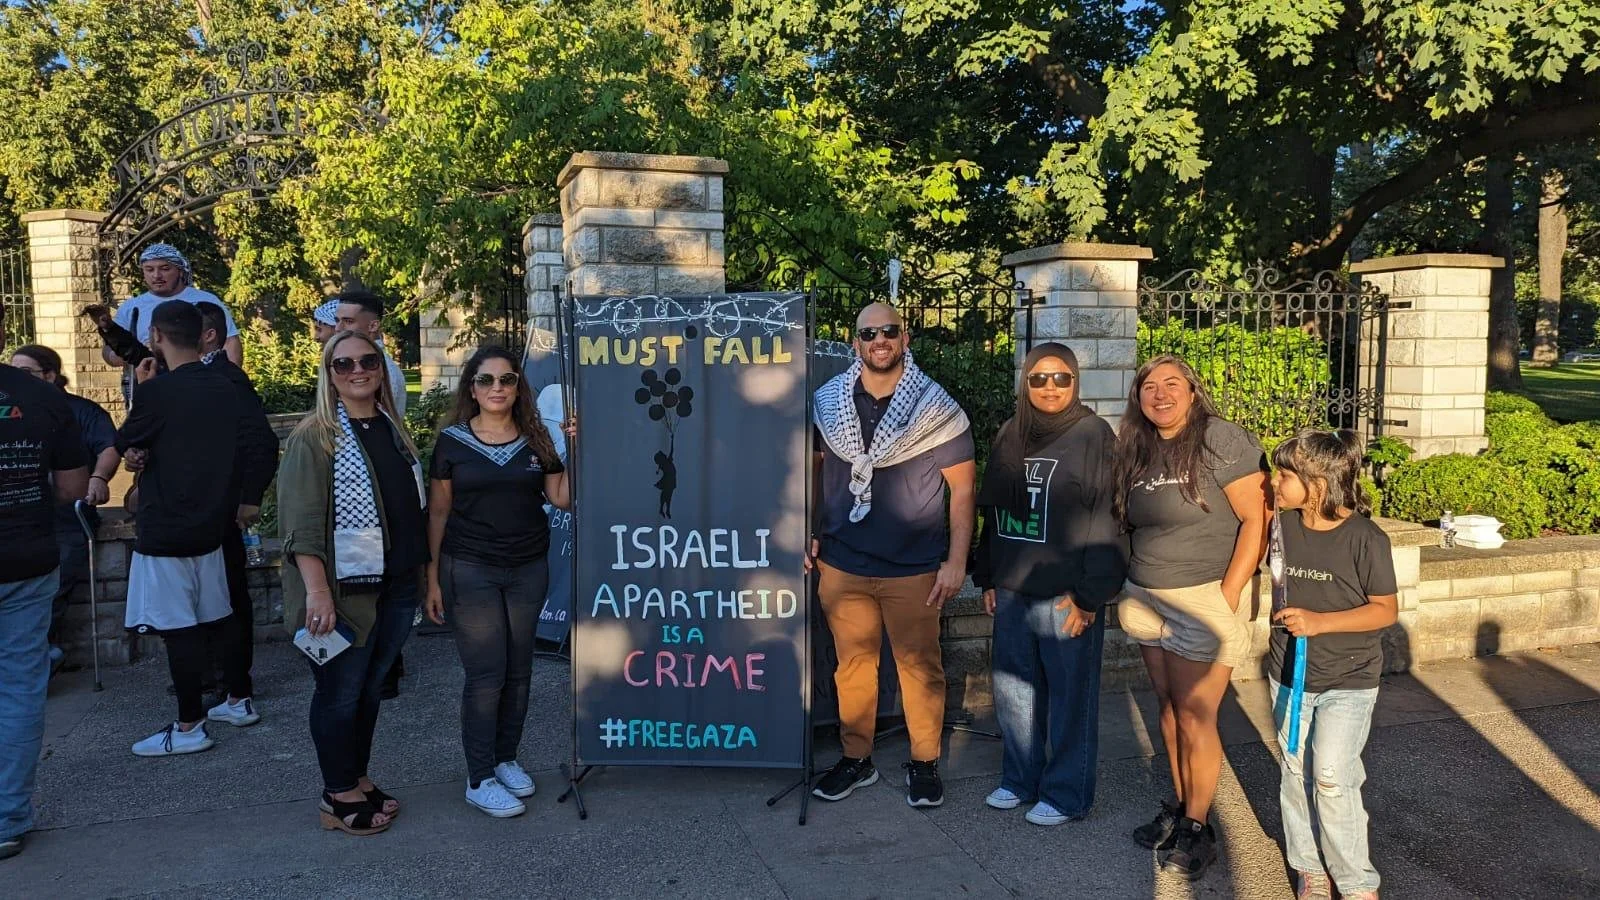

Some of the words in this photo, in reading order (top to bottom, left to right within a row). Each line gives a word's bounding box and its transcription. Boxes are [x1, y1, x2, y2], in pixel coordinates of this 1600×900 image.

[116, 93, 284, 184] VICTORIA
[578, 335, 683, 366] MUST
[703, 335, 792, 366] FALL
[551, 508, 573, 536] BR
[610, 525, 771, 569] ISRAELI
[1283, 566, 1307, 579] alvin
[1307, 568, 1333, 581] Klein
[591, 583, 797, 620] APARTHEID
[662, 625, 681, 644] IS
[687, 627, 704, 644] A
[623, 650, 766, 692] CRIME
[599, 717, 757, 749] #FREEGAZA
